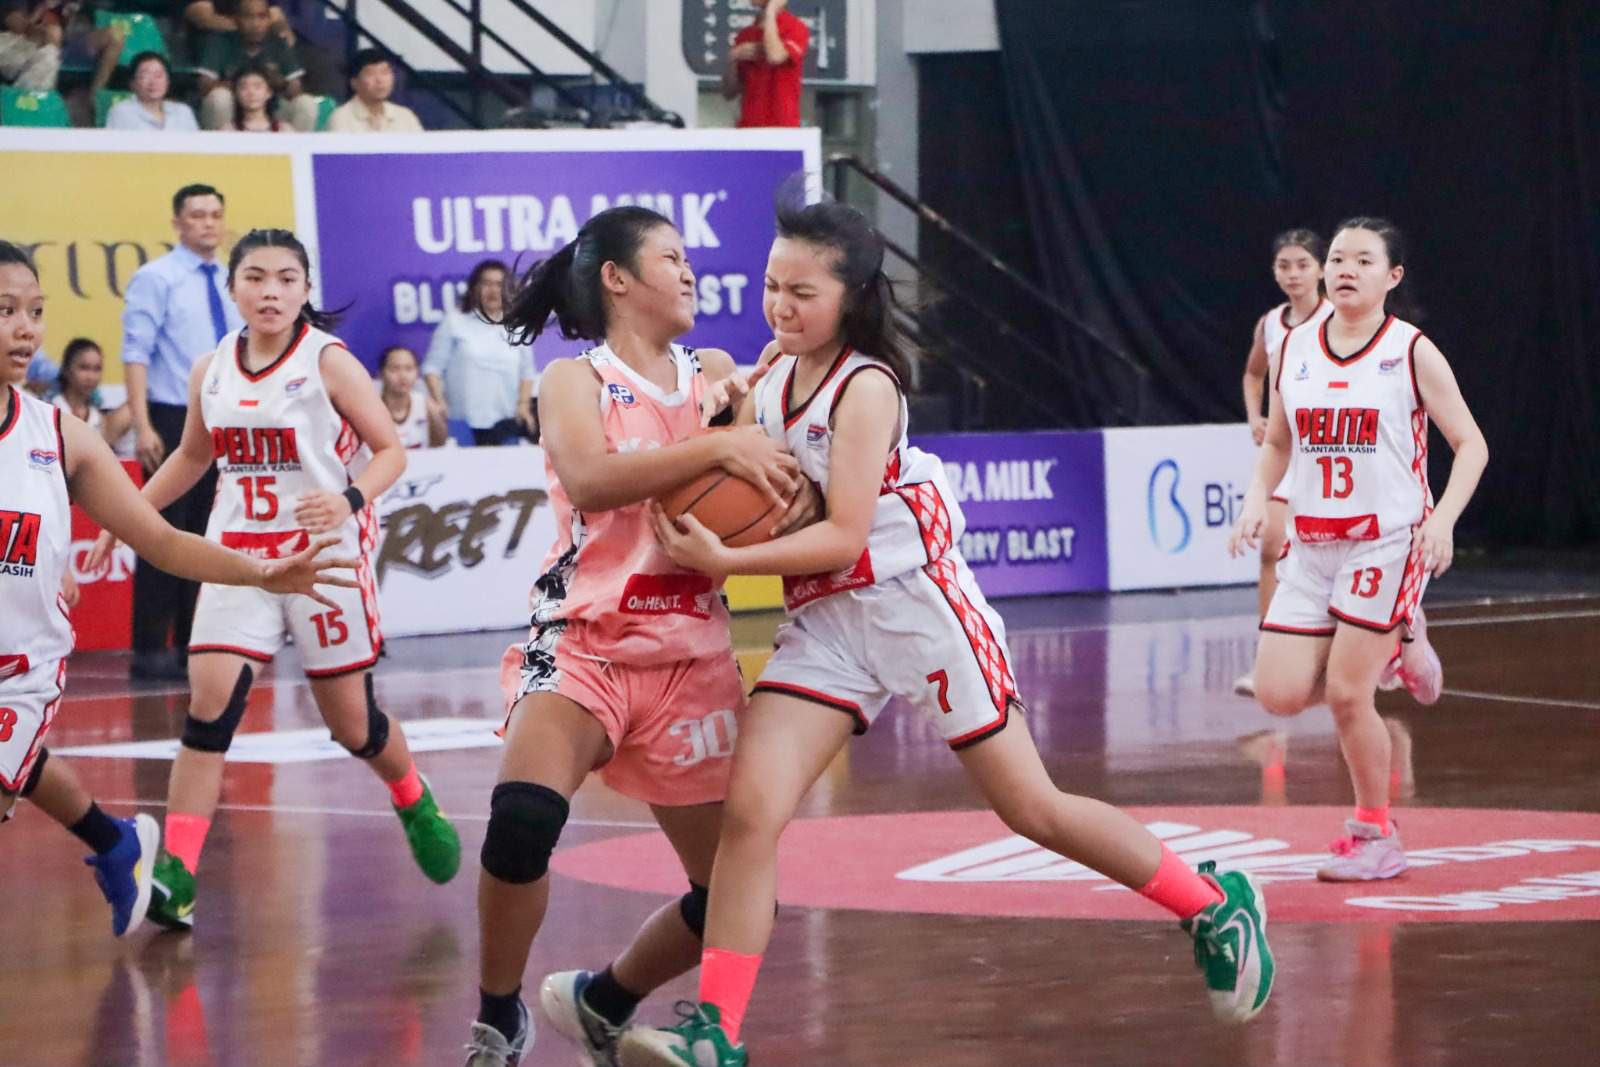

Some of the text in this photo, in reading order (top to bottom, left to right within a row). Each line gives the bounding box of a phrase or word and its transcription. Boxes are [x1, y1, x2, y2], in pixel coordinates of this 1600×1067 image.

[412, 196, 580, 254] ULTRA
[211, 426, 301, 465] PELITA
[1296, 407, 1379, 446] PELITA
[1348, 446, 1376, 454] KASIH
[985, 459, 1054, 500] MILK
[1316, 456, 1354, 499] 13
[237, 476, 278, 521] 15
[1205, 483, 1244, 528] Bi
[1007, 526, 1076, 562] BLAST
[1350, 566, 1383, 599] 13
[309, 609, 348, 648] 15
[926, 668, 952, 714] 7
[669, 709, 738, 767] 30
